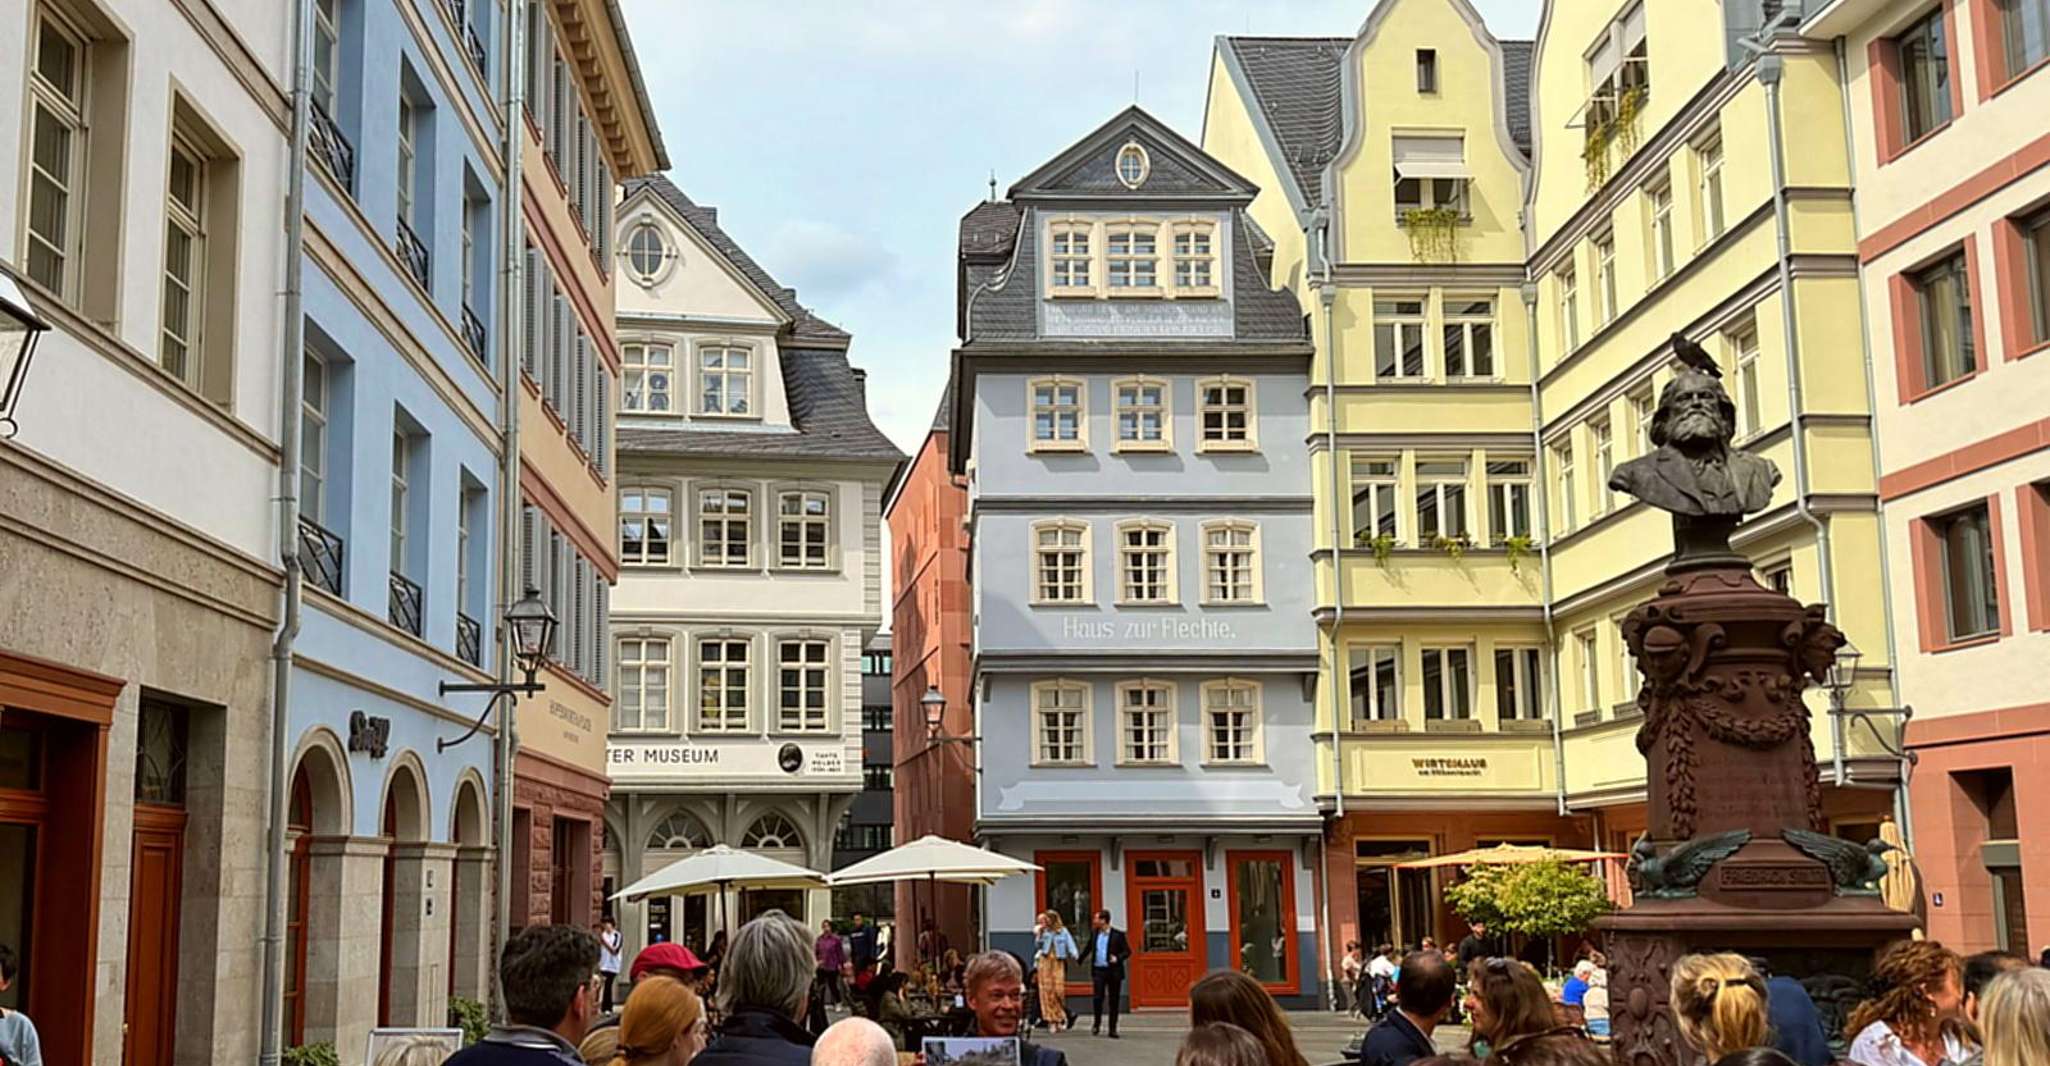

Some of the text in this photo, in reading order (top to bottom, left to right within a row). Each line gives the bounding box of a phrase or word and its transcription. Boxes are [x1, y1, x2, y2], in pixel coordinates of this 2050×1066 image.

[1063, 616, 1236, 639] Haus zur Flechte.
[644, 748, 719, 763] MUSEUM
